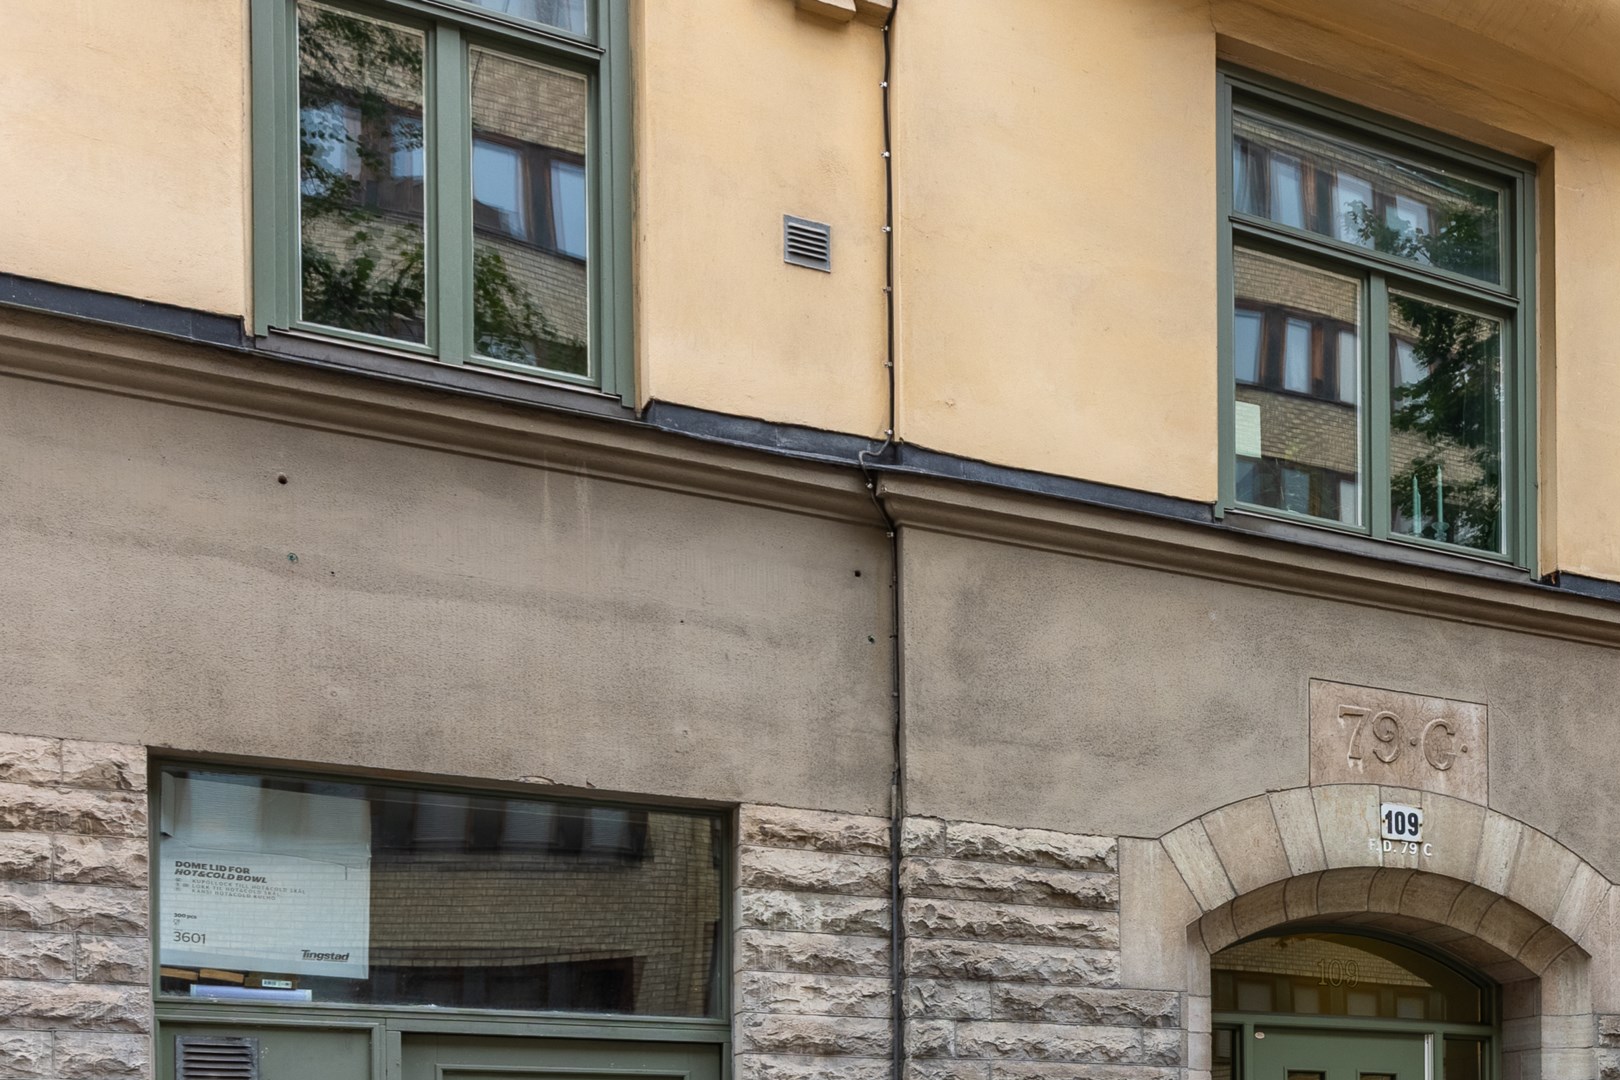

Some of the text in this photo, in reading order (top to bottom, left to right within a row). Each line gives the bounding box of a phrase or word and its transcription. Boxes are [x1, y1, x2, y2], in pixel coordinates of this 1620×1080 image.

[1384, 809, 1420, 837] 109
[1400, 841, 1418, 855] 79
[1423, 842, 1433, 856] C
[175, 860, 250, 875] DOME LID FOR
[174, 868, 268, 884] HOT&COLD BOWL
[235, 882, 249, 890] TILL
[173, 931, 207, 945] 3601
[301, 949, 350, 962] Tingstad
[1317, 959, 1360, 989] 109
